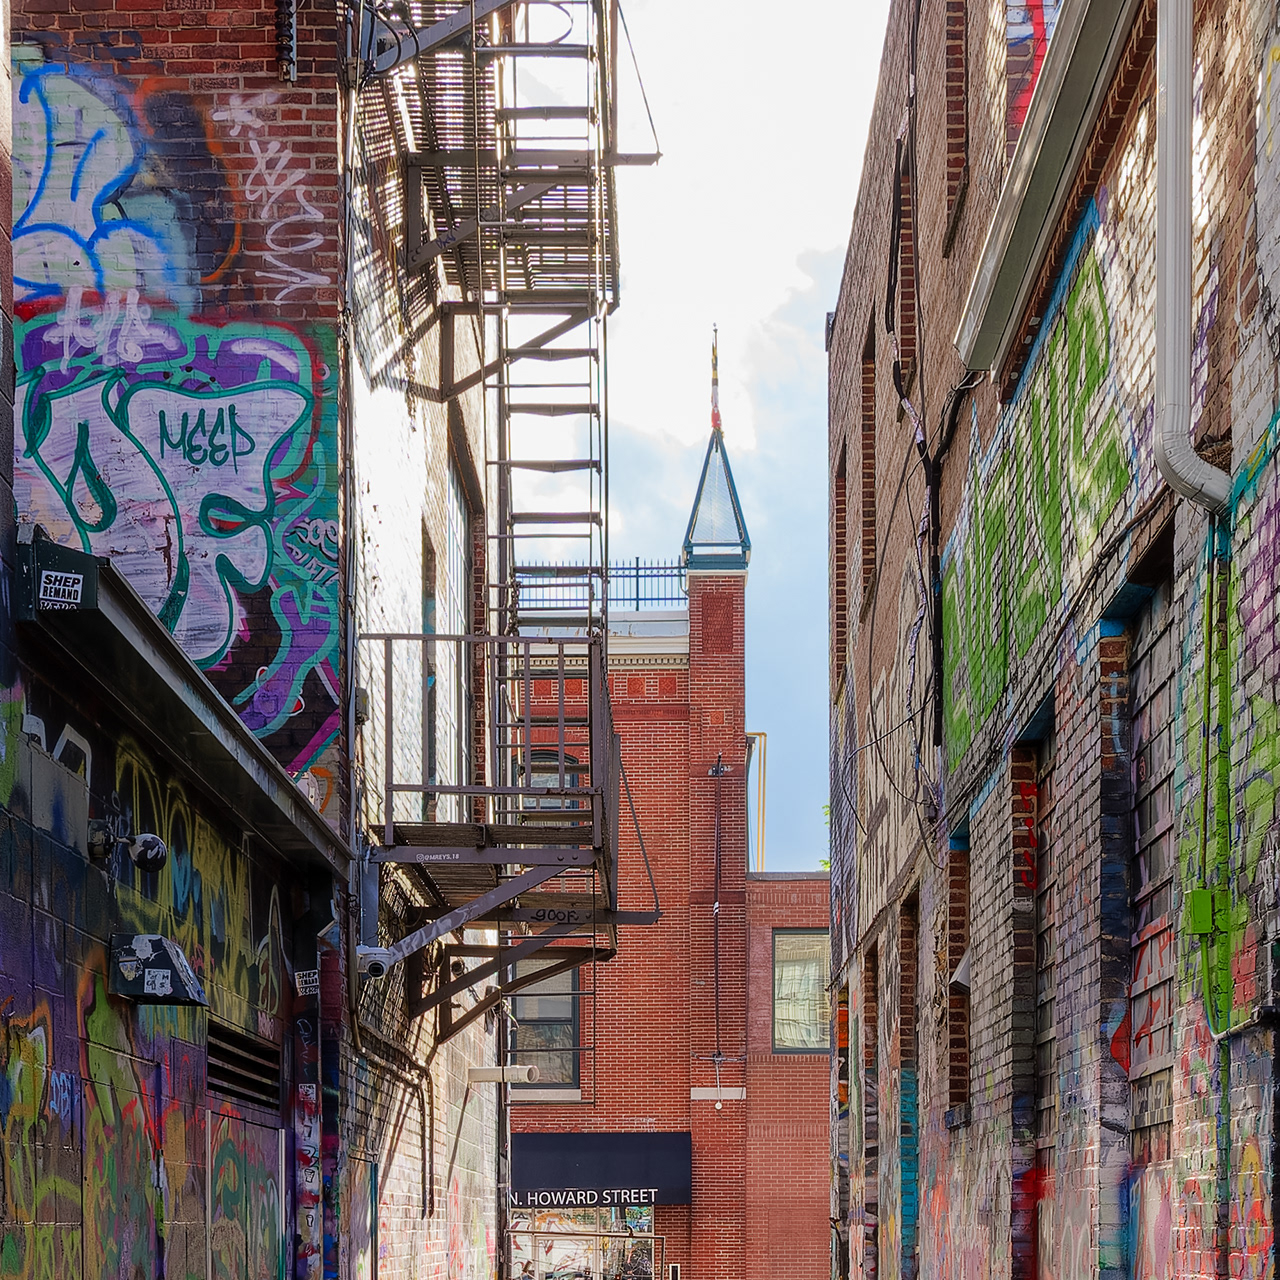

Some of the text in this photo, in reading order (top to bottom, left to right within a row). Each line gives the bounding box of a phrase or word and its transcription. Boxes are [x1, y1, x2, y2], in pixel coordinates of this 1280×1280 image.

[43, 574, 81, 588] SHEP
[43, 586, 79, 600] REMAND
[527, 1190, 598, 1206] HOWARD
[603, 1188, 658, 1204] STREET
